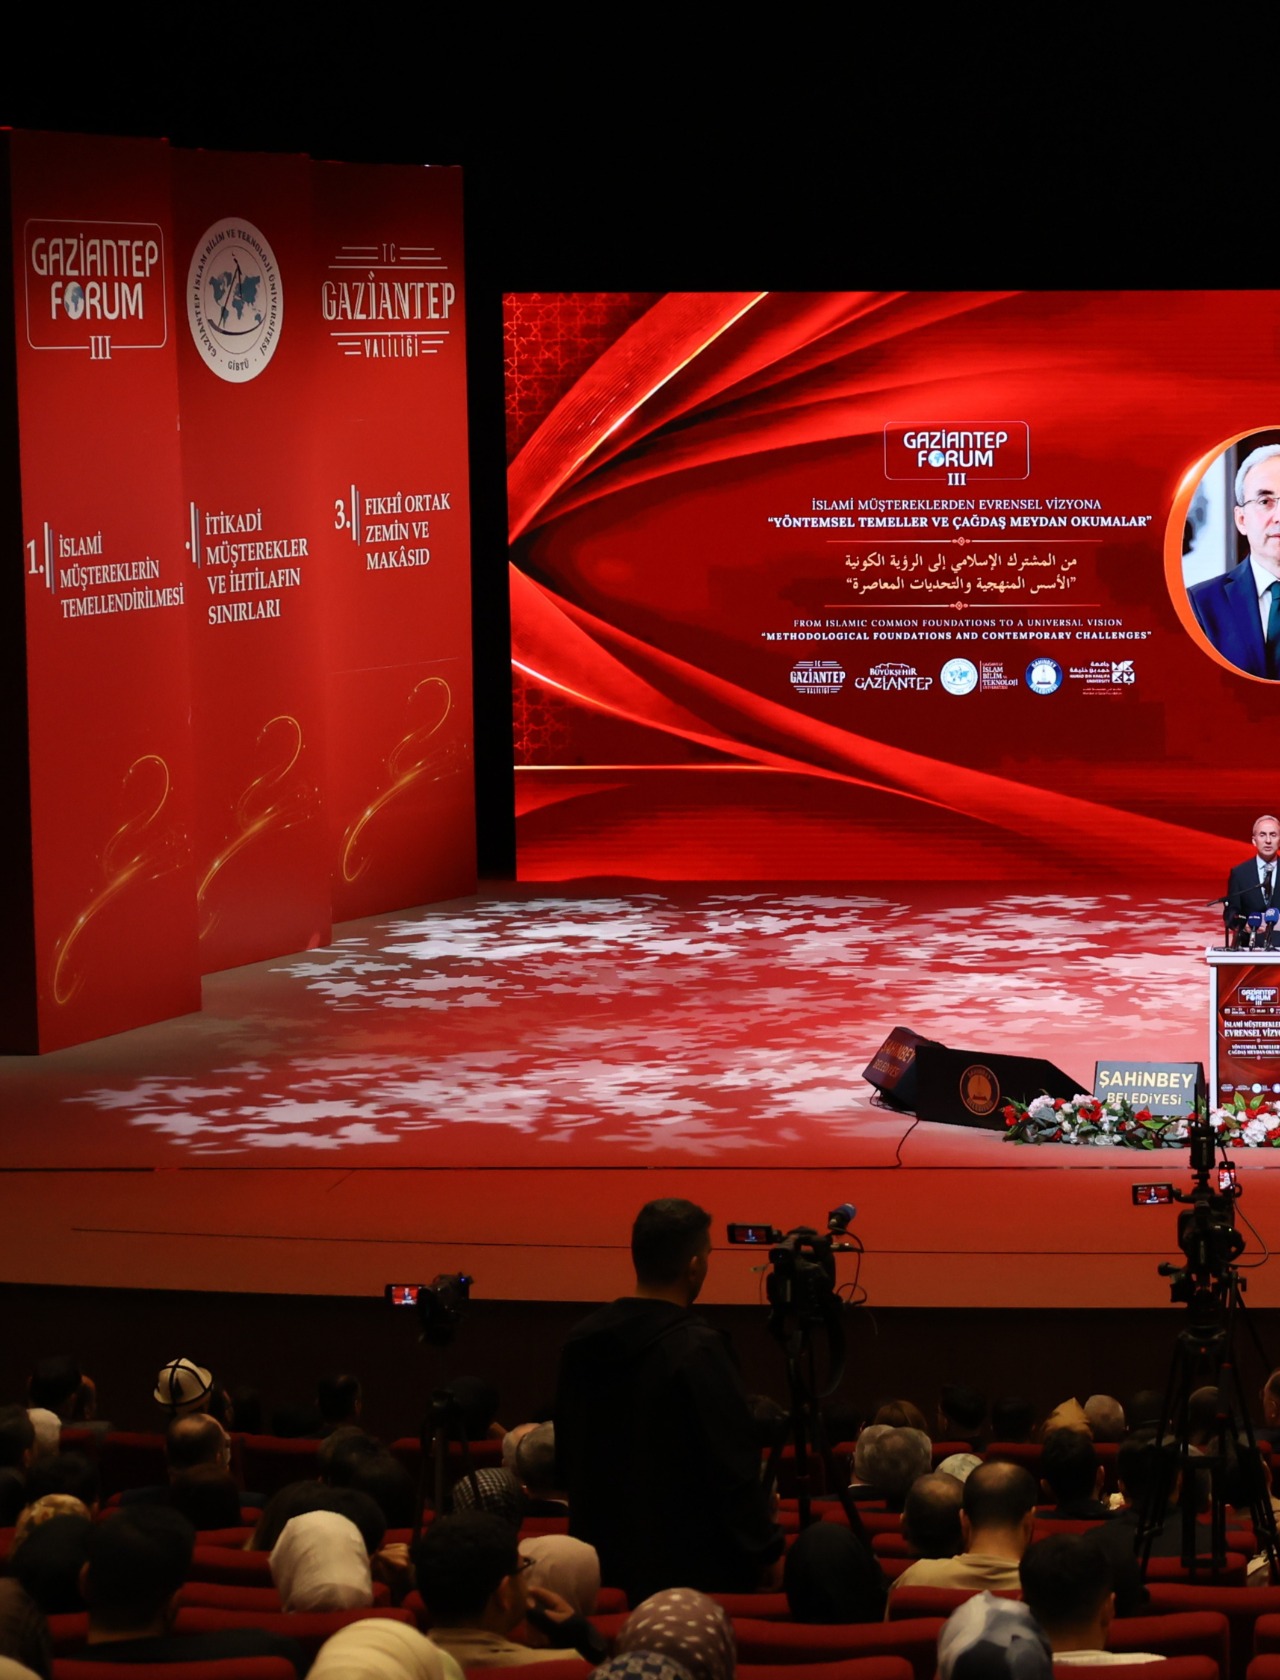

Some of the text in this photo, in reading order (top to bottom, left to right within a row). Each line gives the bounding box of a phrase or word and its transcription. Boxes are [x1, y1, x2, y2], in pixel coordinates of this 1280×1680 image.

[32, 234, 158, 277] GAZİANTEP
[193, 255, 207, 290] İSLAM
[205, 232, 225, 254] BİLİM
[226, 229, 236, 239] VE
[52, 282, 143, 320] FORUM
[323, 272, 455, 320] GAZİANTEP
[88, 336, 114, 359] III
[228, 359, 250, 371] GİBTÜ
[904, 430, 1007, 451] GAZİANTEP
[918, 450, 992, 467] FORUM
[948, 473, 966, 485] III
[335, 497, 353, 531] 3.
[366, 492, 450, 515] FIKHÎ ORTAK
[812, 497, 1101, 512] İSLAMİ MÜŞTEREKLERDEN EVRENSEL VİZYONA
[206, 509, 262, 535] İTİKADİ
[366, 520, 429, 542] ZEMİN VE
[768, 515, 1152, 530] “YÖNTEMSEL TEMELLER VE ÇAĞDAŞ MEYDAN OKUMALAR”
[59, 531, 102, 557] İSLAMİ
[207, 538, 308, 569] MÜŞTEREKLER
[27, 538, 46, 574] 1.
[367, 546, 429, 570] MAKÂSID
[846, 552, 1076, 573] من المشترك الإسلامي إلى الرؤية الكونية
[60, 554, 159, 590] MÜŞTEREKLERİN
[207, 564, 300, 594] VE İHTİLAFIN
[910, 576, 971, 593] والتحديات
[977, 576, 1025, 593] المنهجية
[61, 580, 184, 618] TEMELLENDİRİLMESİ
[209, 599, 280, 624] SINIRLARI
[874, 632, 951, 640] FOUNDATIONS
[790, 668, 845, 683] GAZİANTEP
[855, 675, 932, 690] GAZİANTEP
[1224, 1029, 1261, 1037] EVRENSEL
